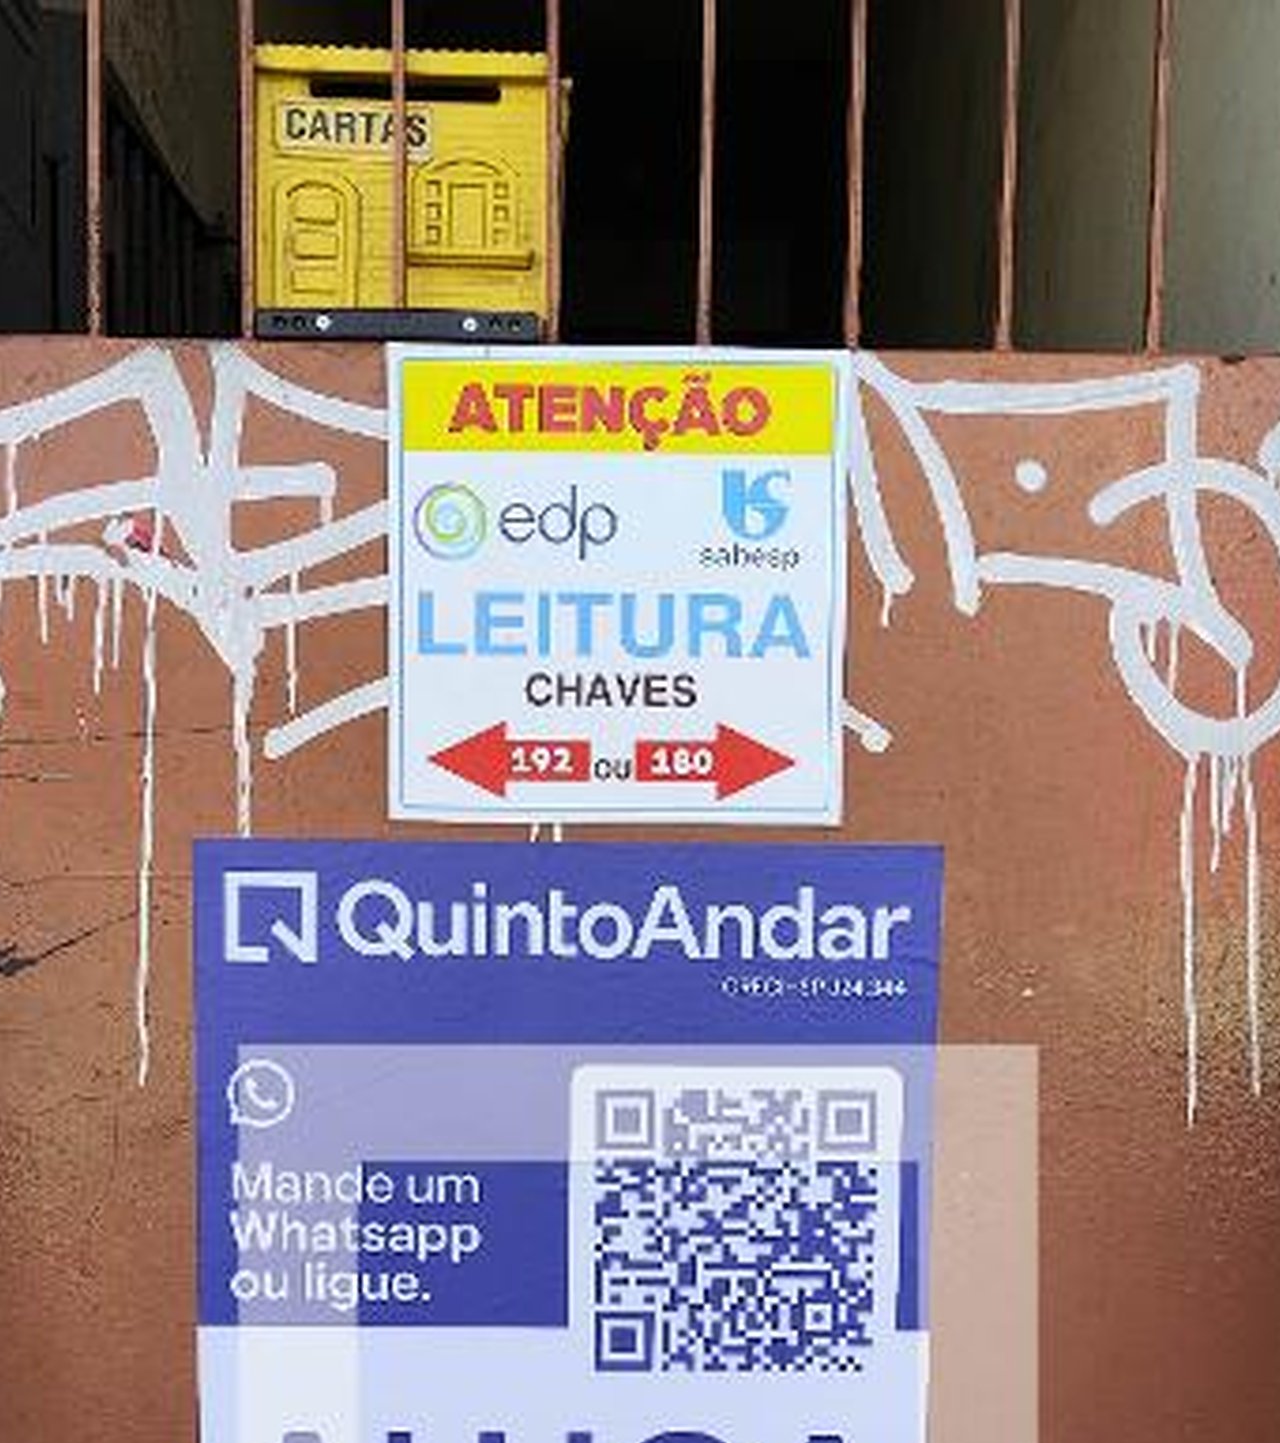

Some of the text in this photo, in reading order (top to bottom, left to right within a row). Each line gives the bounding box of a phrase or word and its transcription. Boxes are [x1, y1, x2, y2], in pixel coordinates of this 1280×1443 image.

[448, 376, 772, 452] ATENÇÃO
[499, 485, 619, 559] edp
[698, 542, 801, 571] sabesp
[417, 590, 811, 659] LEITURA
[525, 673, 698, 708] CHAVES
[509, 745, 714, 781] 192 ou 180
[335, 878, 913, 963] QuintoAndar
[230, 1162, 481, 1204] Mande um
[229, 1211, 481, 1262] Whatsapp
[230, 1264, 432, 1312] ou ligue.
